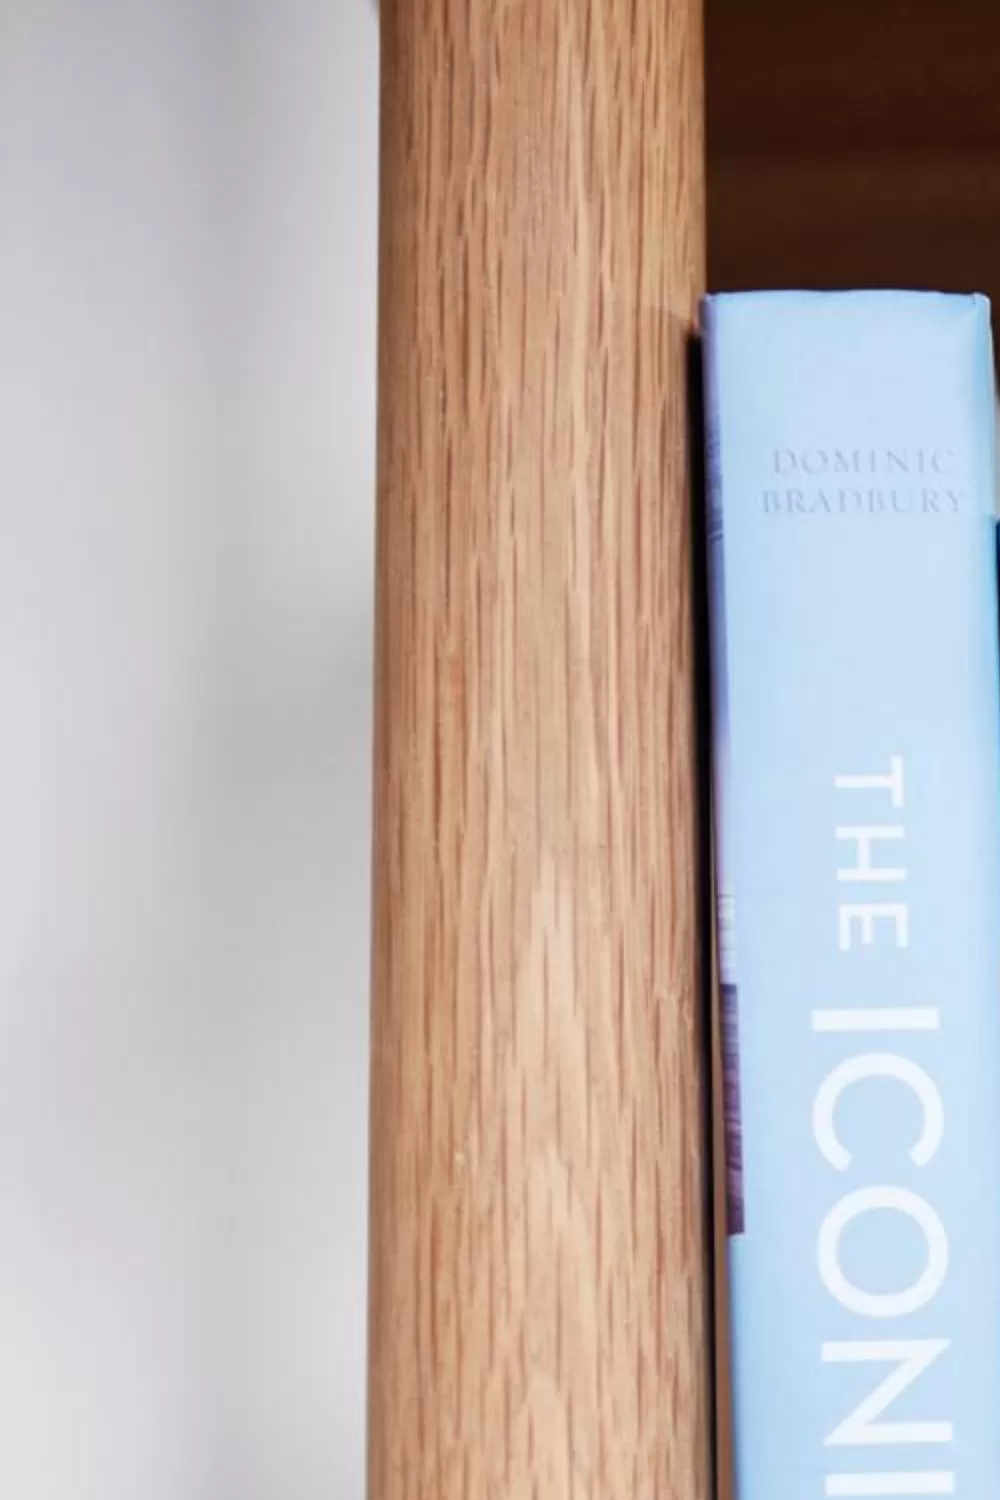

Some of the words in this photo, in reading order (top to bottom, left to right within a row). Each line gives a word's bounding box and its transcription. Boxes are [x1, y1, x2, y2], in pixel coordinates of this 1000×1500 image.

[771, 447, 956, 475] DOMINIC
[762, 488, 964, 515] BRADBURY
[834, 755, 908, 950] THE
